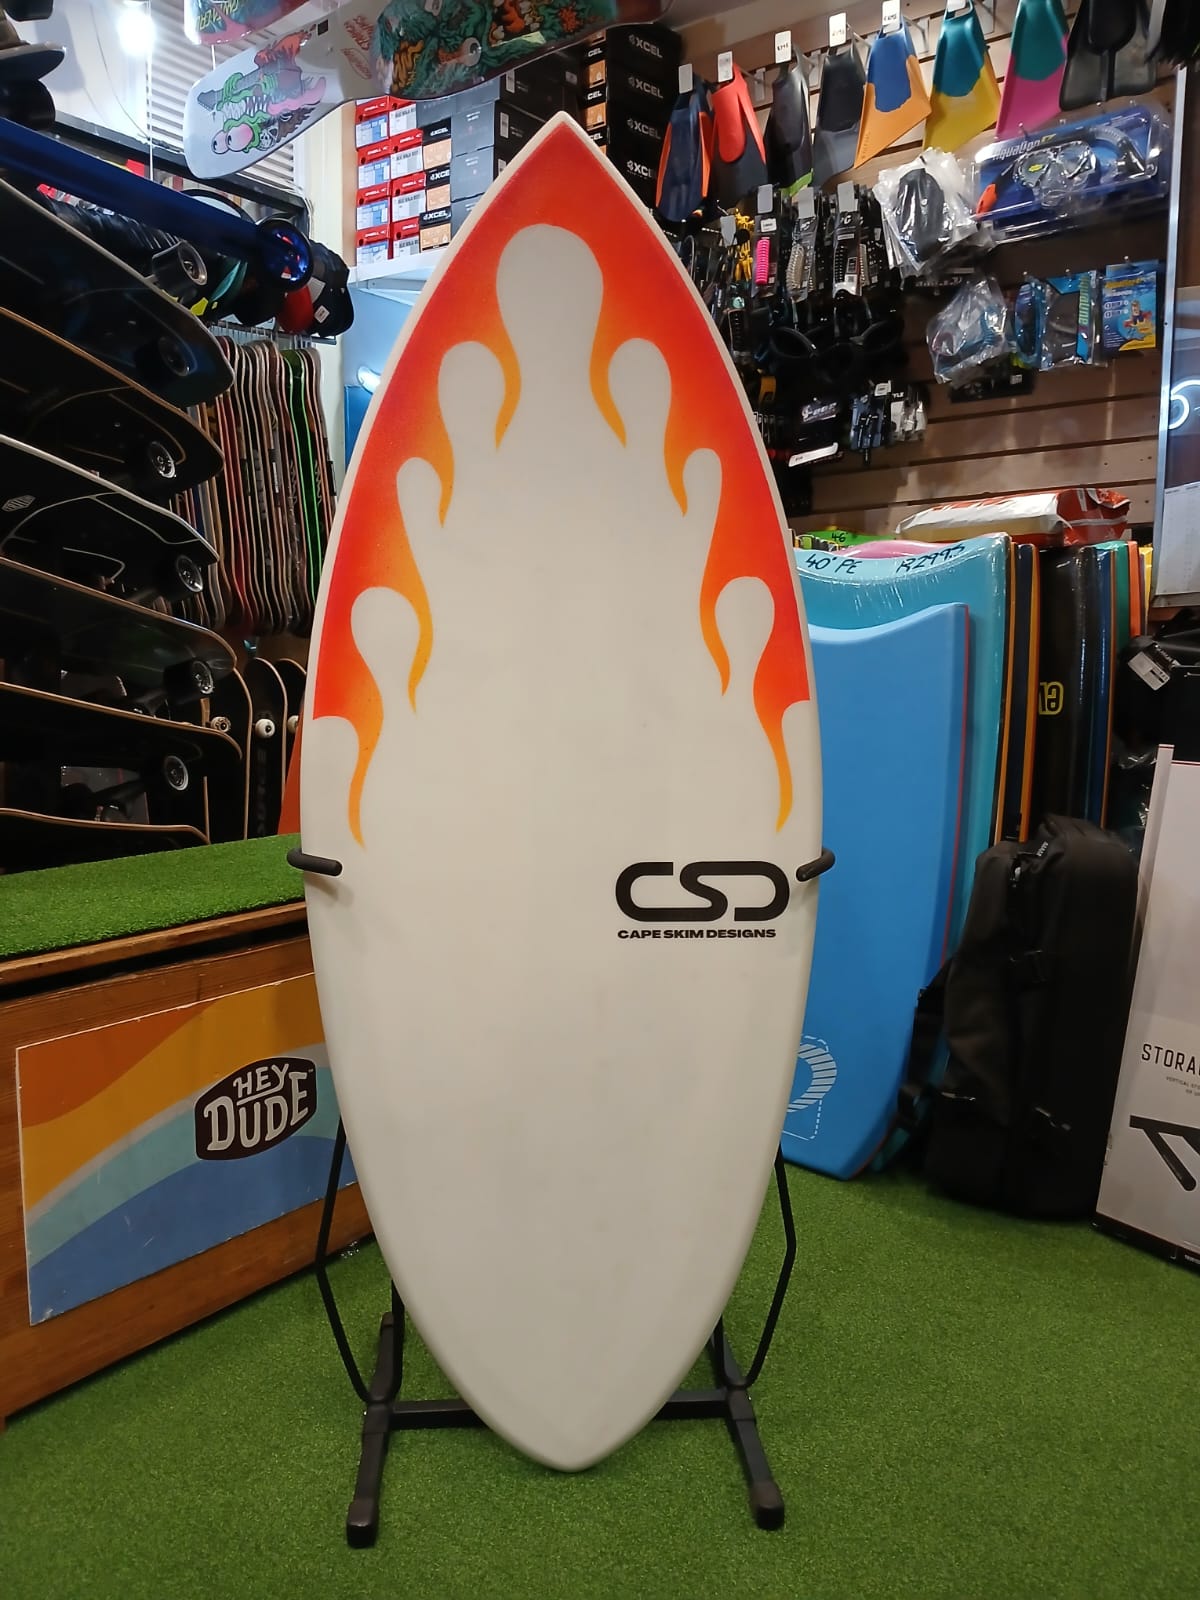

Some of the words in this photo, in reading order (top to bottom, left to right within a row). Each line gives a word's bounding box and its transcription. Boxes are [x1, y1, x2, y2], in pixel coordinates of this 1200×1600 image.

[835, 559, 863, 575] PE
[615, 861, 790, 922] CSD
[617, 930, 662, 940] CAPE
[663, 929, 705, 939] SKIM
[705, 928, 777, 939] DESIGNS
[1141, 1043, 1200, 1076] STORA
[233, 1064, 289, 1098] HEY
[204, 1071, 308, 1151] DUDE
